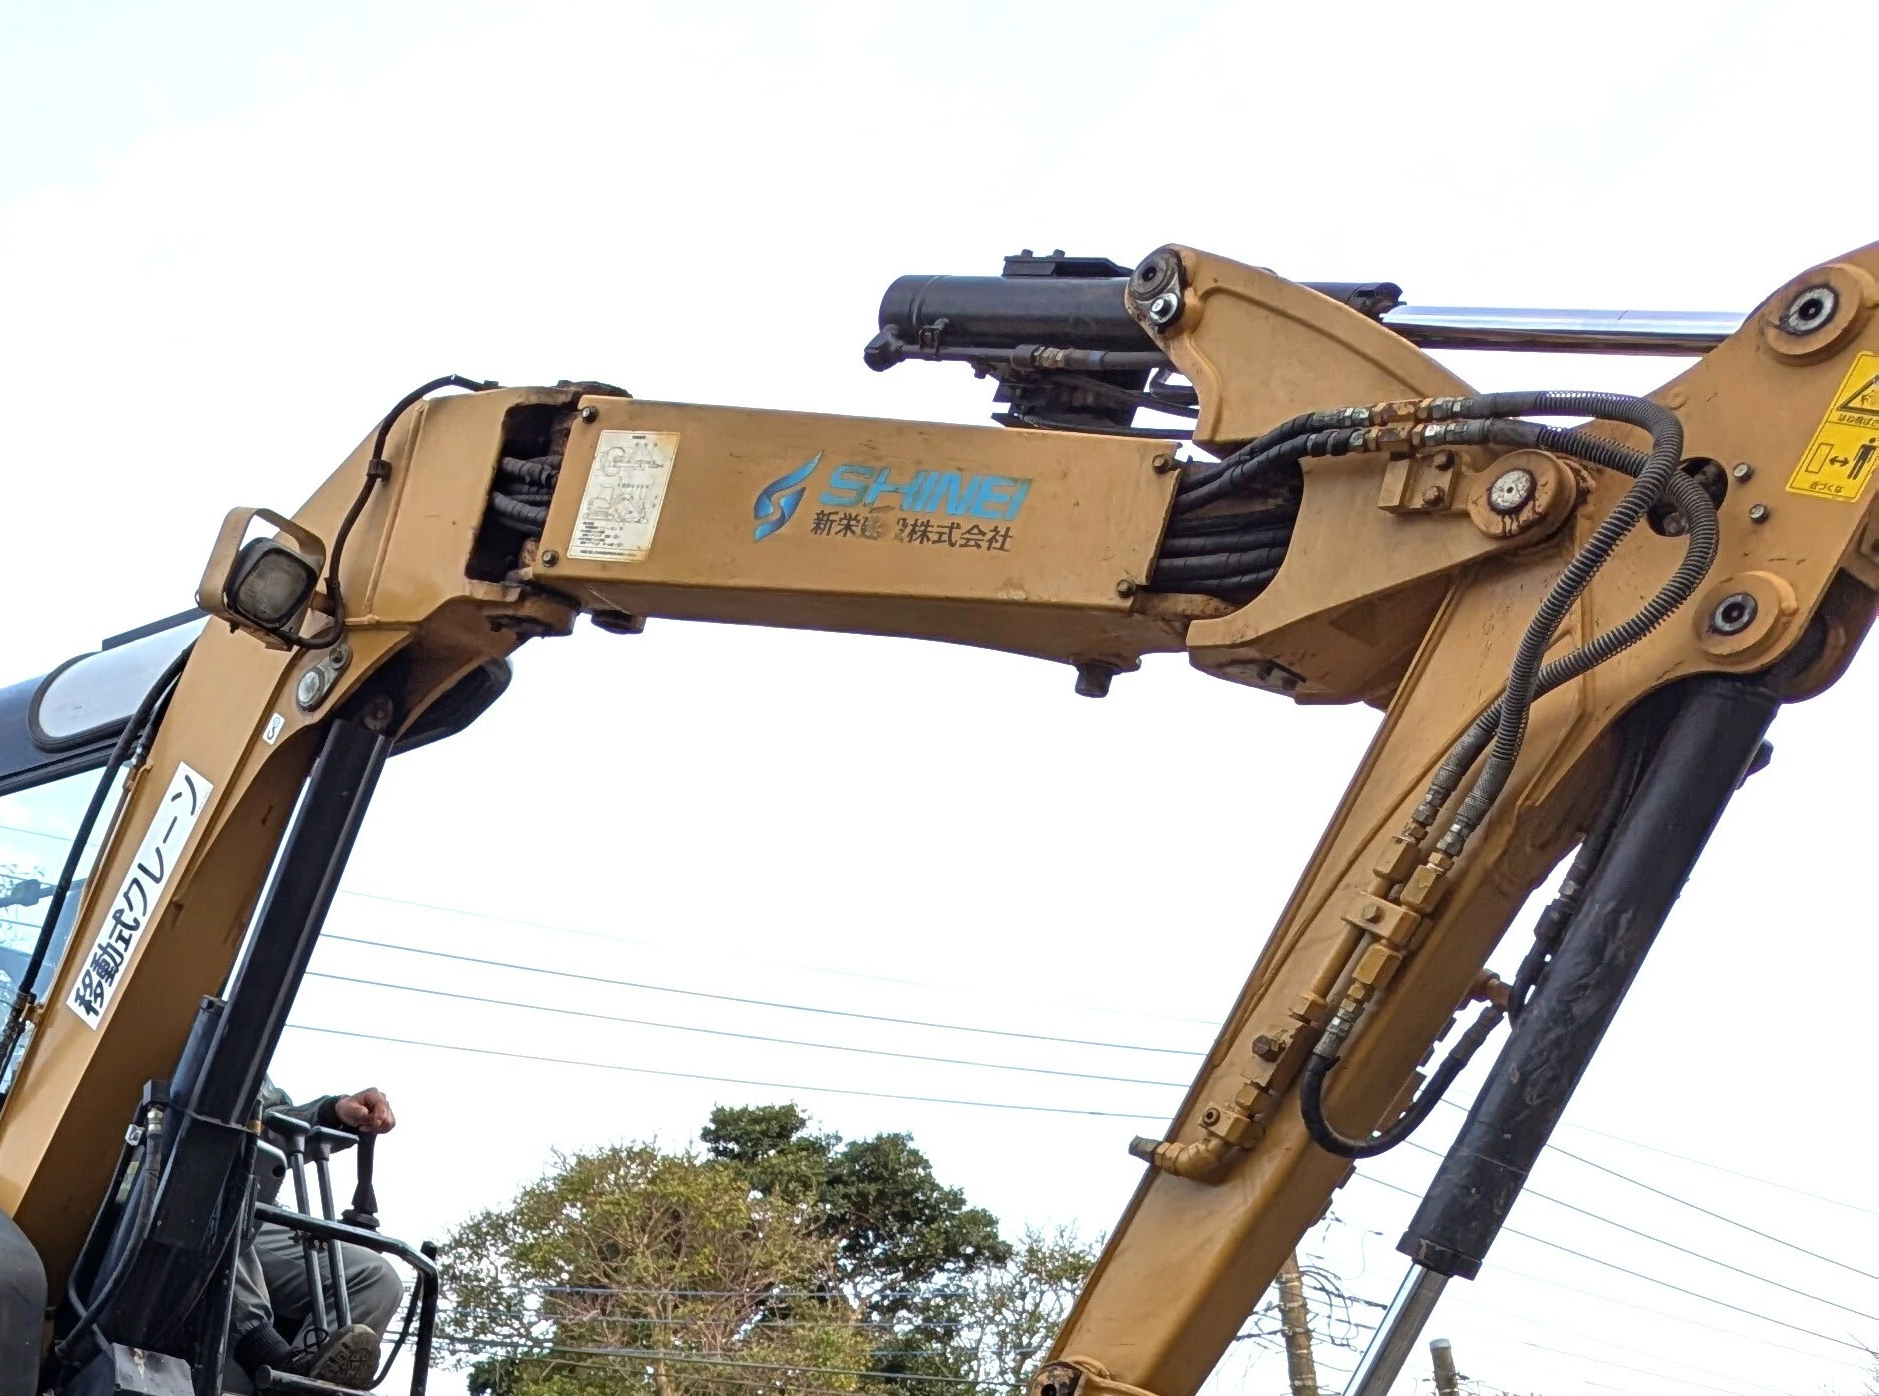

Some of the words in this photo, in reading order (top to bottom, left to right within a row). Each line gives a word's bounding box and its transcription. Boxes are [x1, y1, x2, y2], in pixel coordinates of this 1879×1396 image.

[819, 464, 1034, 521] SHINEI
[811, 508, 1014, 553] 新栄株式会社
[74, 774, 197, 1017] 移動式クレーン
